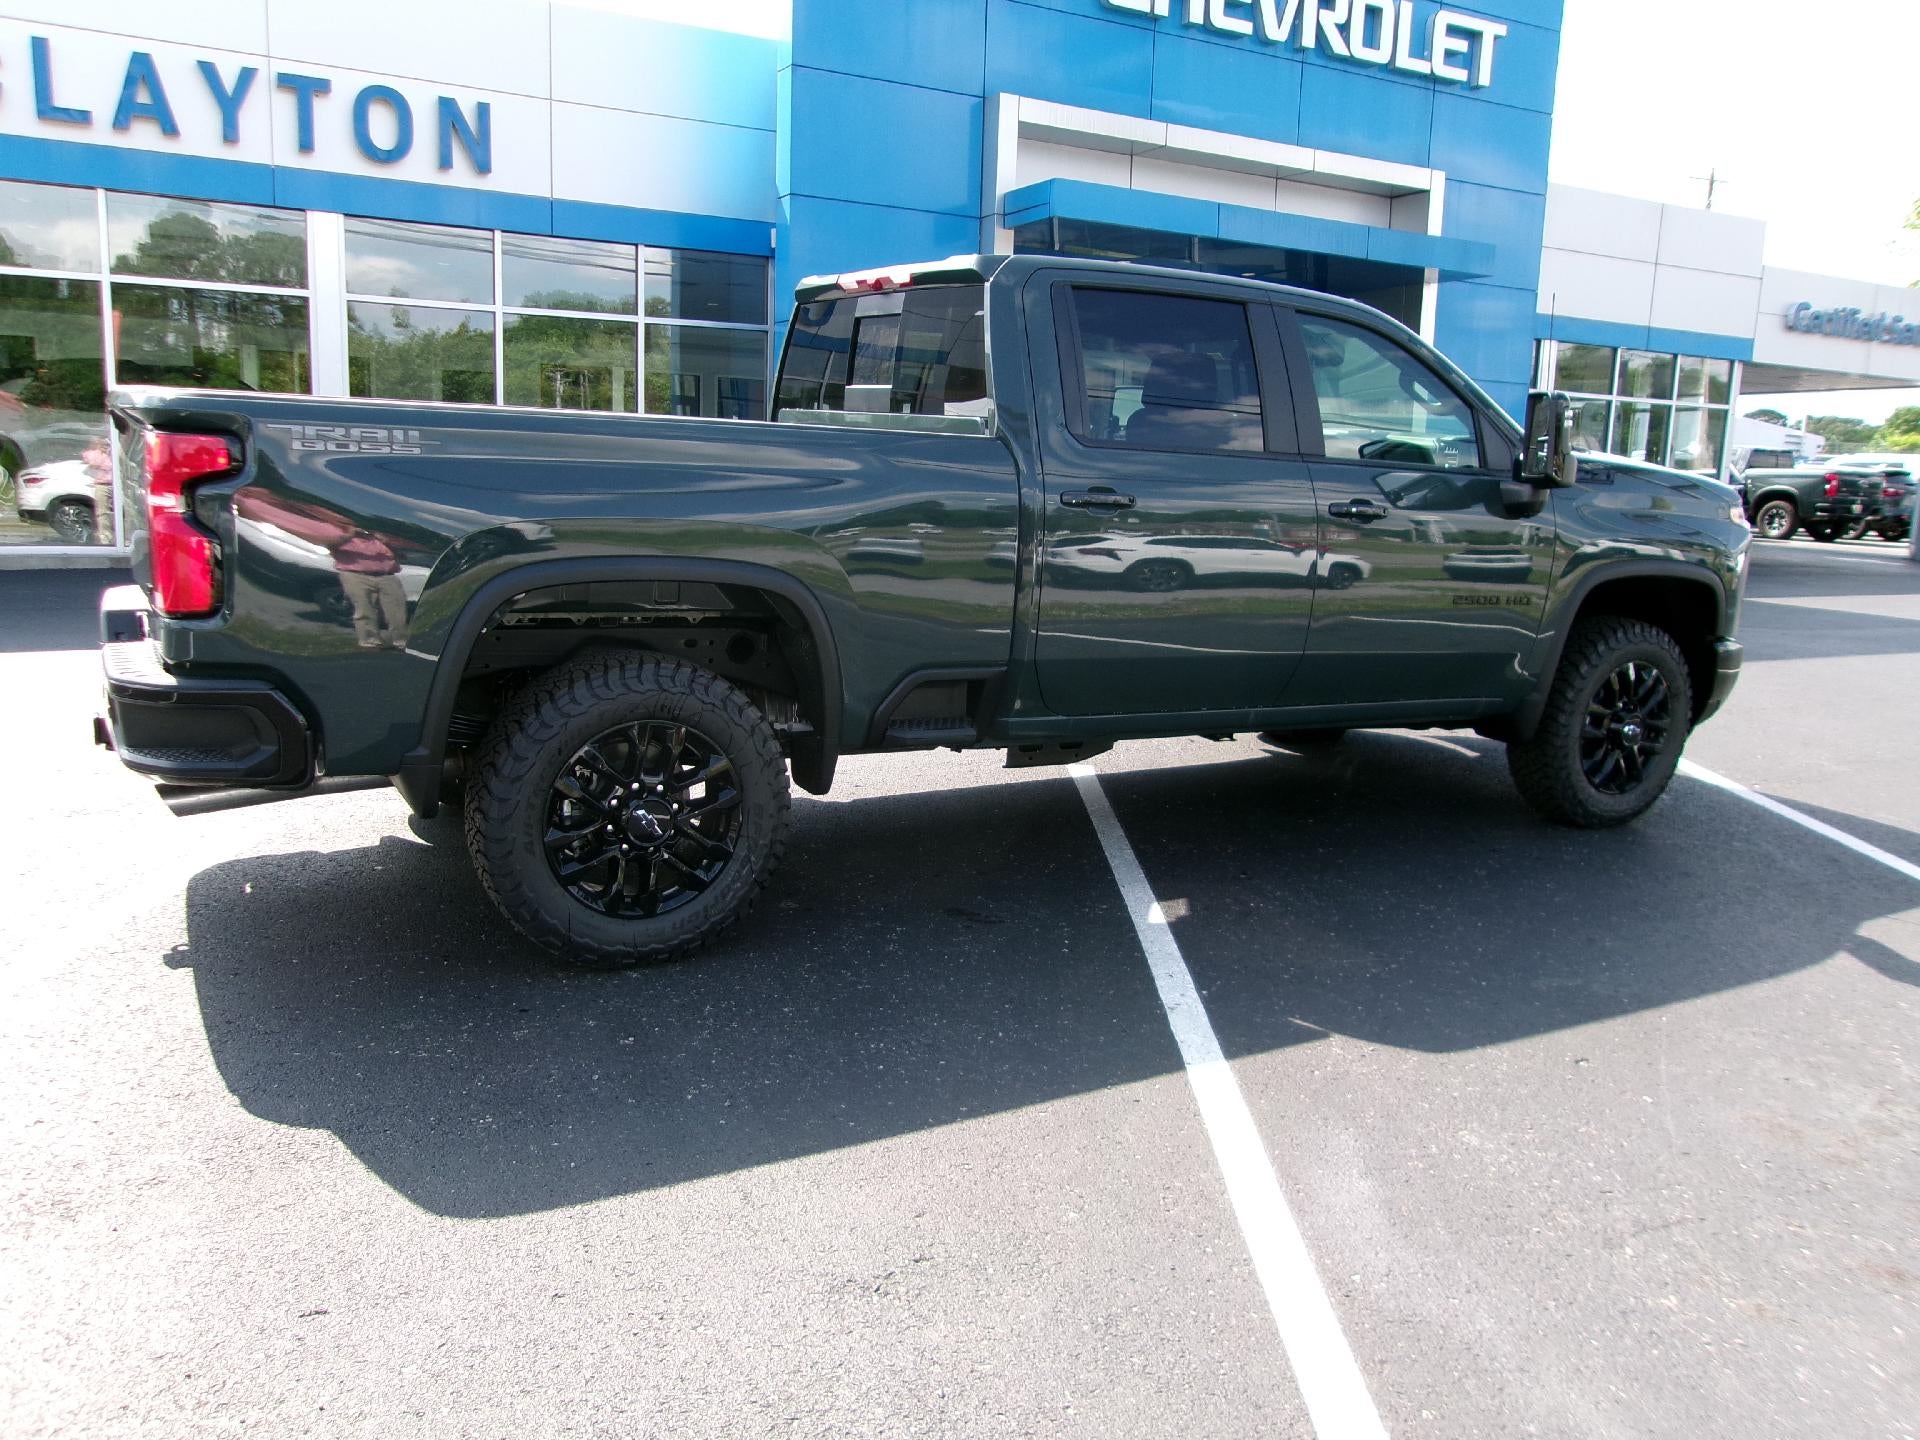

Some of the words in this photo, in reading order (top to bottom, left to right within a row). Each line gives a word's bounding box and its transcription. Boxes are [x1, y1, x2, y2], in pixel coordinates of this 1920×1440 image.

[1104, 0, 1508, 90] EVROLET
[0, 36, 493, 174] LAYTON
[266, 423, 441, 445] TRAIL
[291, 438, 423, 455] BOSS
